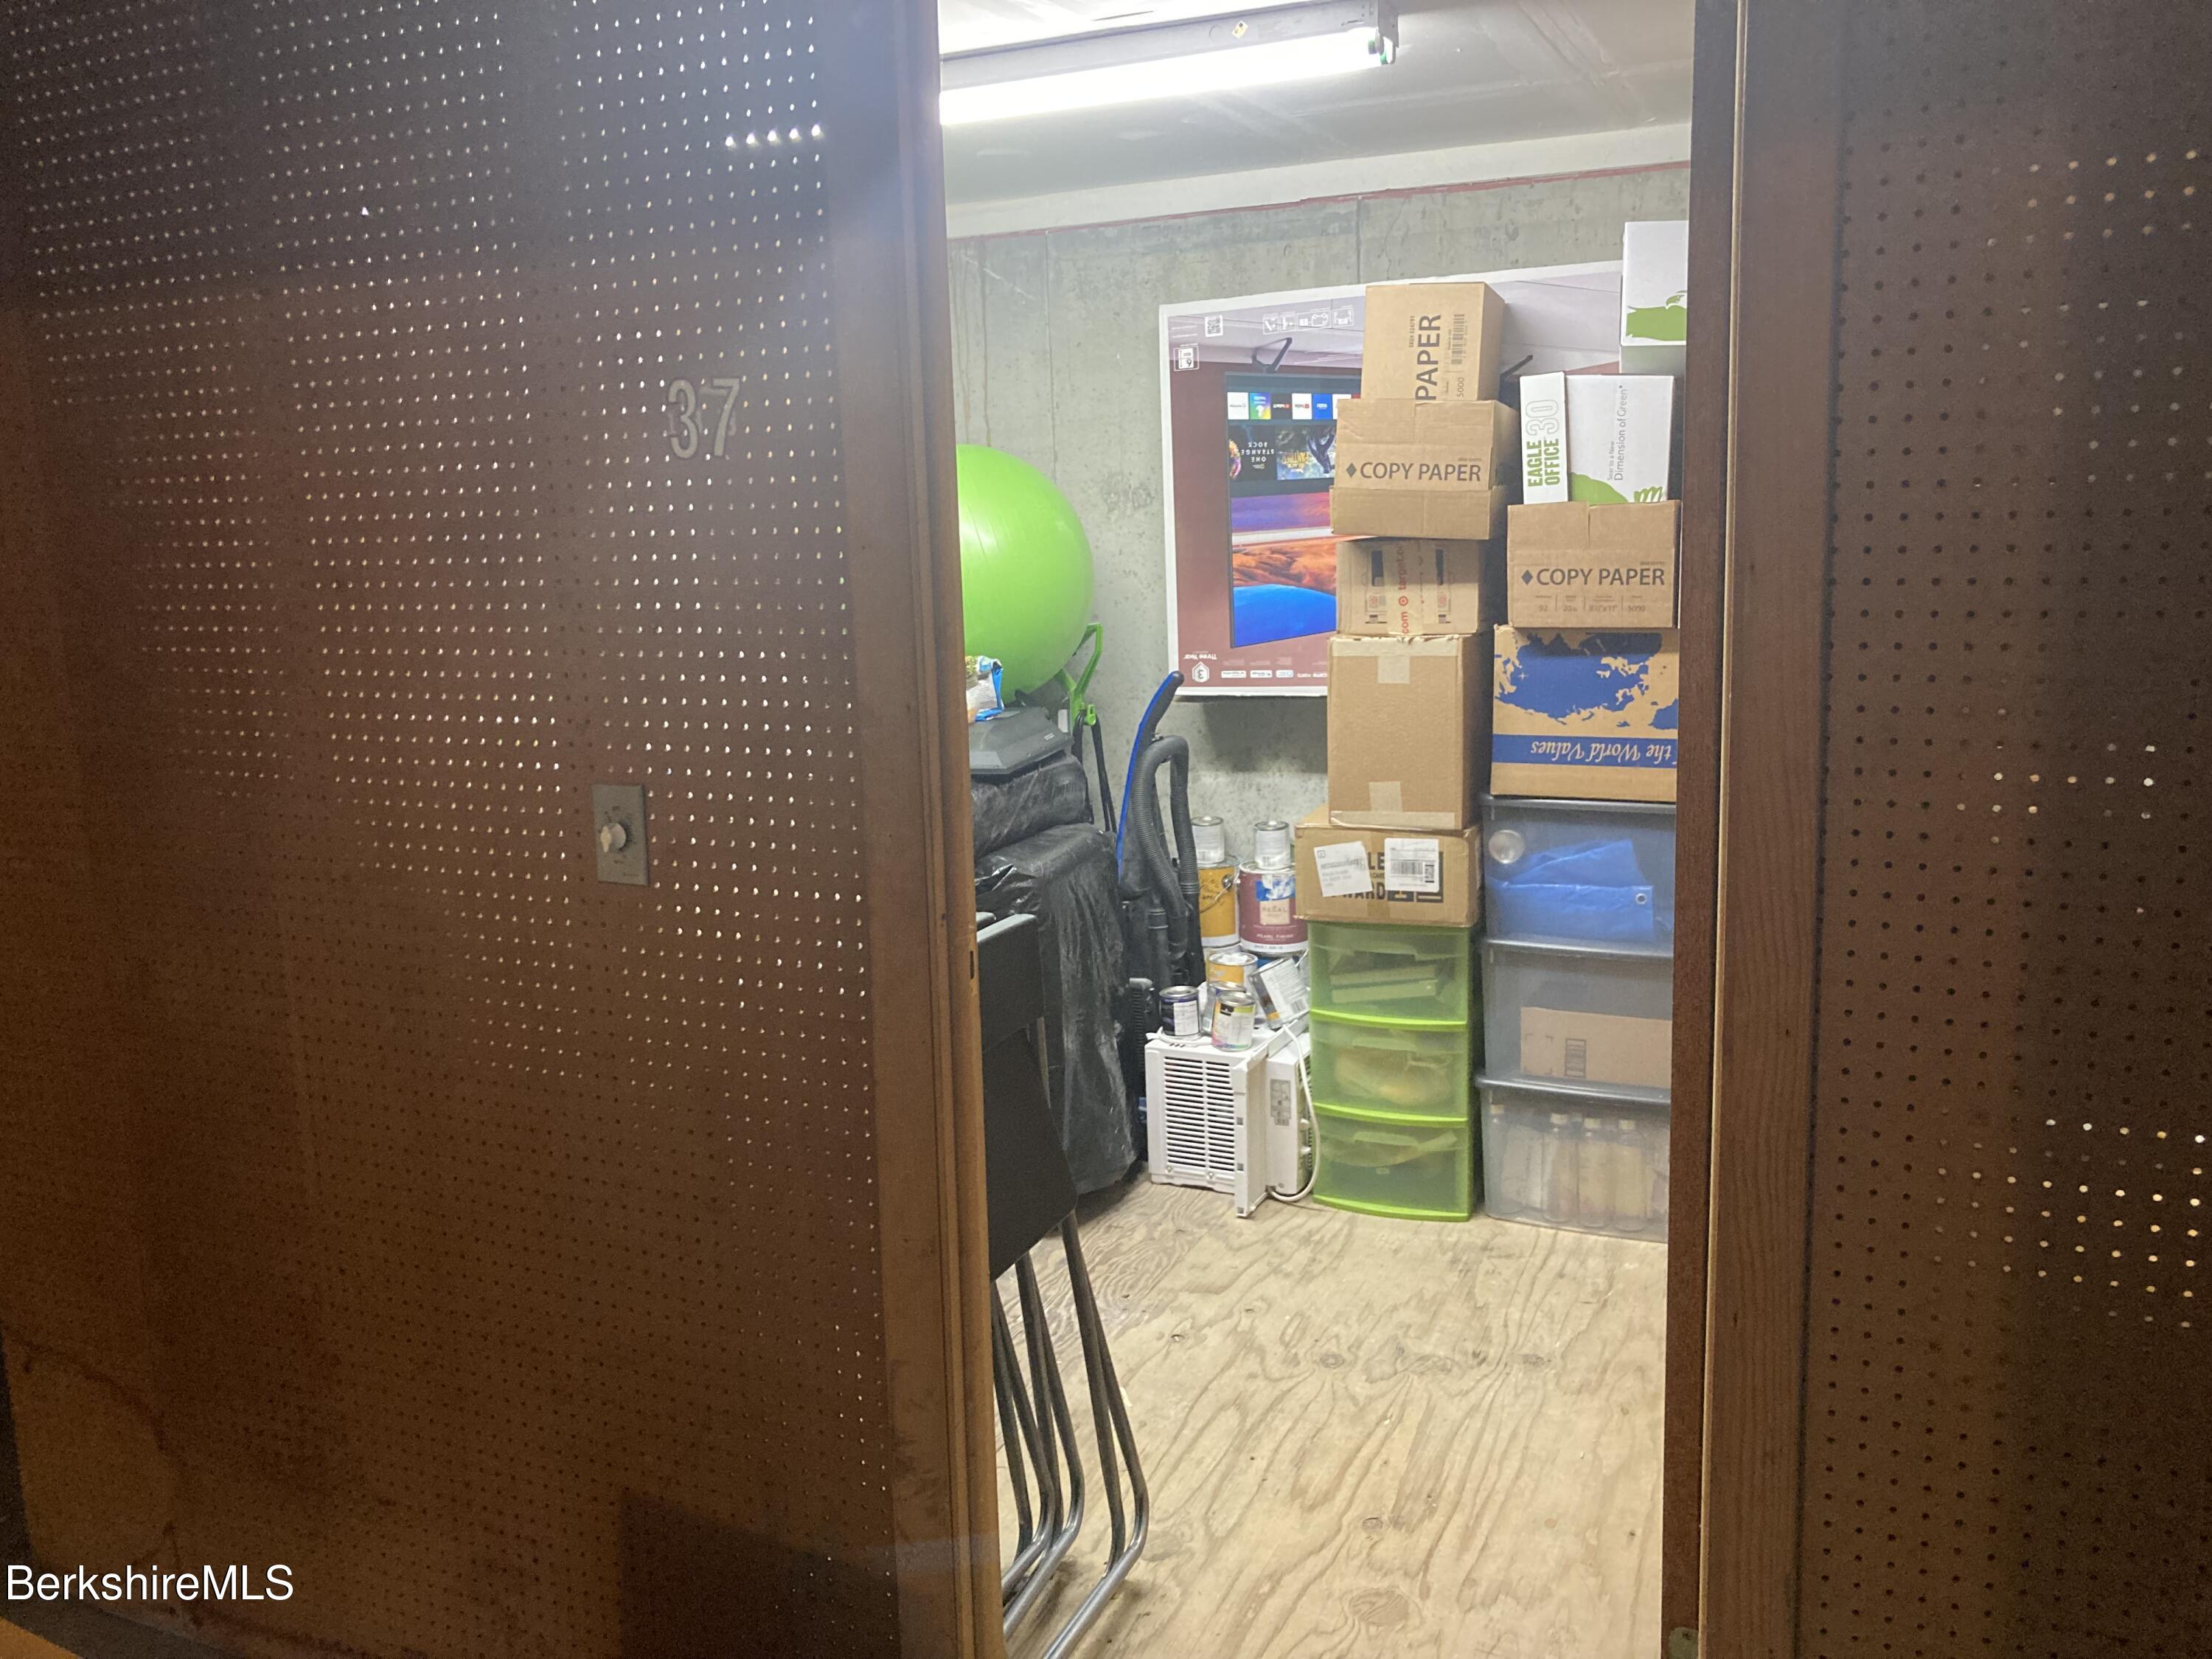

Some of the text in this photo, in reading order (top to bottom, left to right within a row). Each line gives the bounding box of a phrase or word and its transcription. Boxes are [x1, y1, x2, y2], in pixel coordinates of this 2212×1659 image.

[1415, 314, 1441, 400] PAPER
[1456, 377, 1465, 397] 5000
[668, 378, 740, 459] 37
[1526, 400, 1559, 437] 30
[1617, 417, 1627, 428] of
[1526, 440, 1543, 487] EAGLE
[1544, 439, 1559, 486] OFFICE
[1613, 430, 1627, 481] Dimension
[1360, 462, 1481, 481] COPY PAPER
[1537, 568, 1664, 586] COPY PAPER
[1197, 669, 1204, 680] 3
[1531, 742, 1672, 765] the World Values
